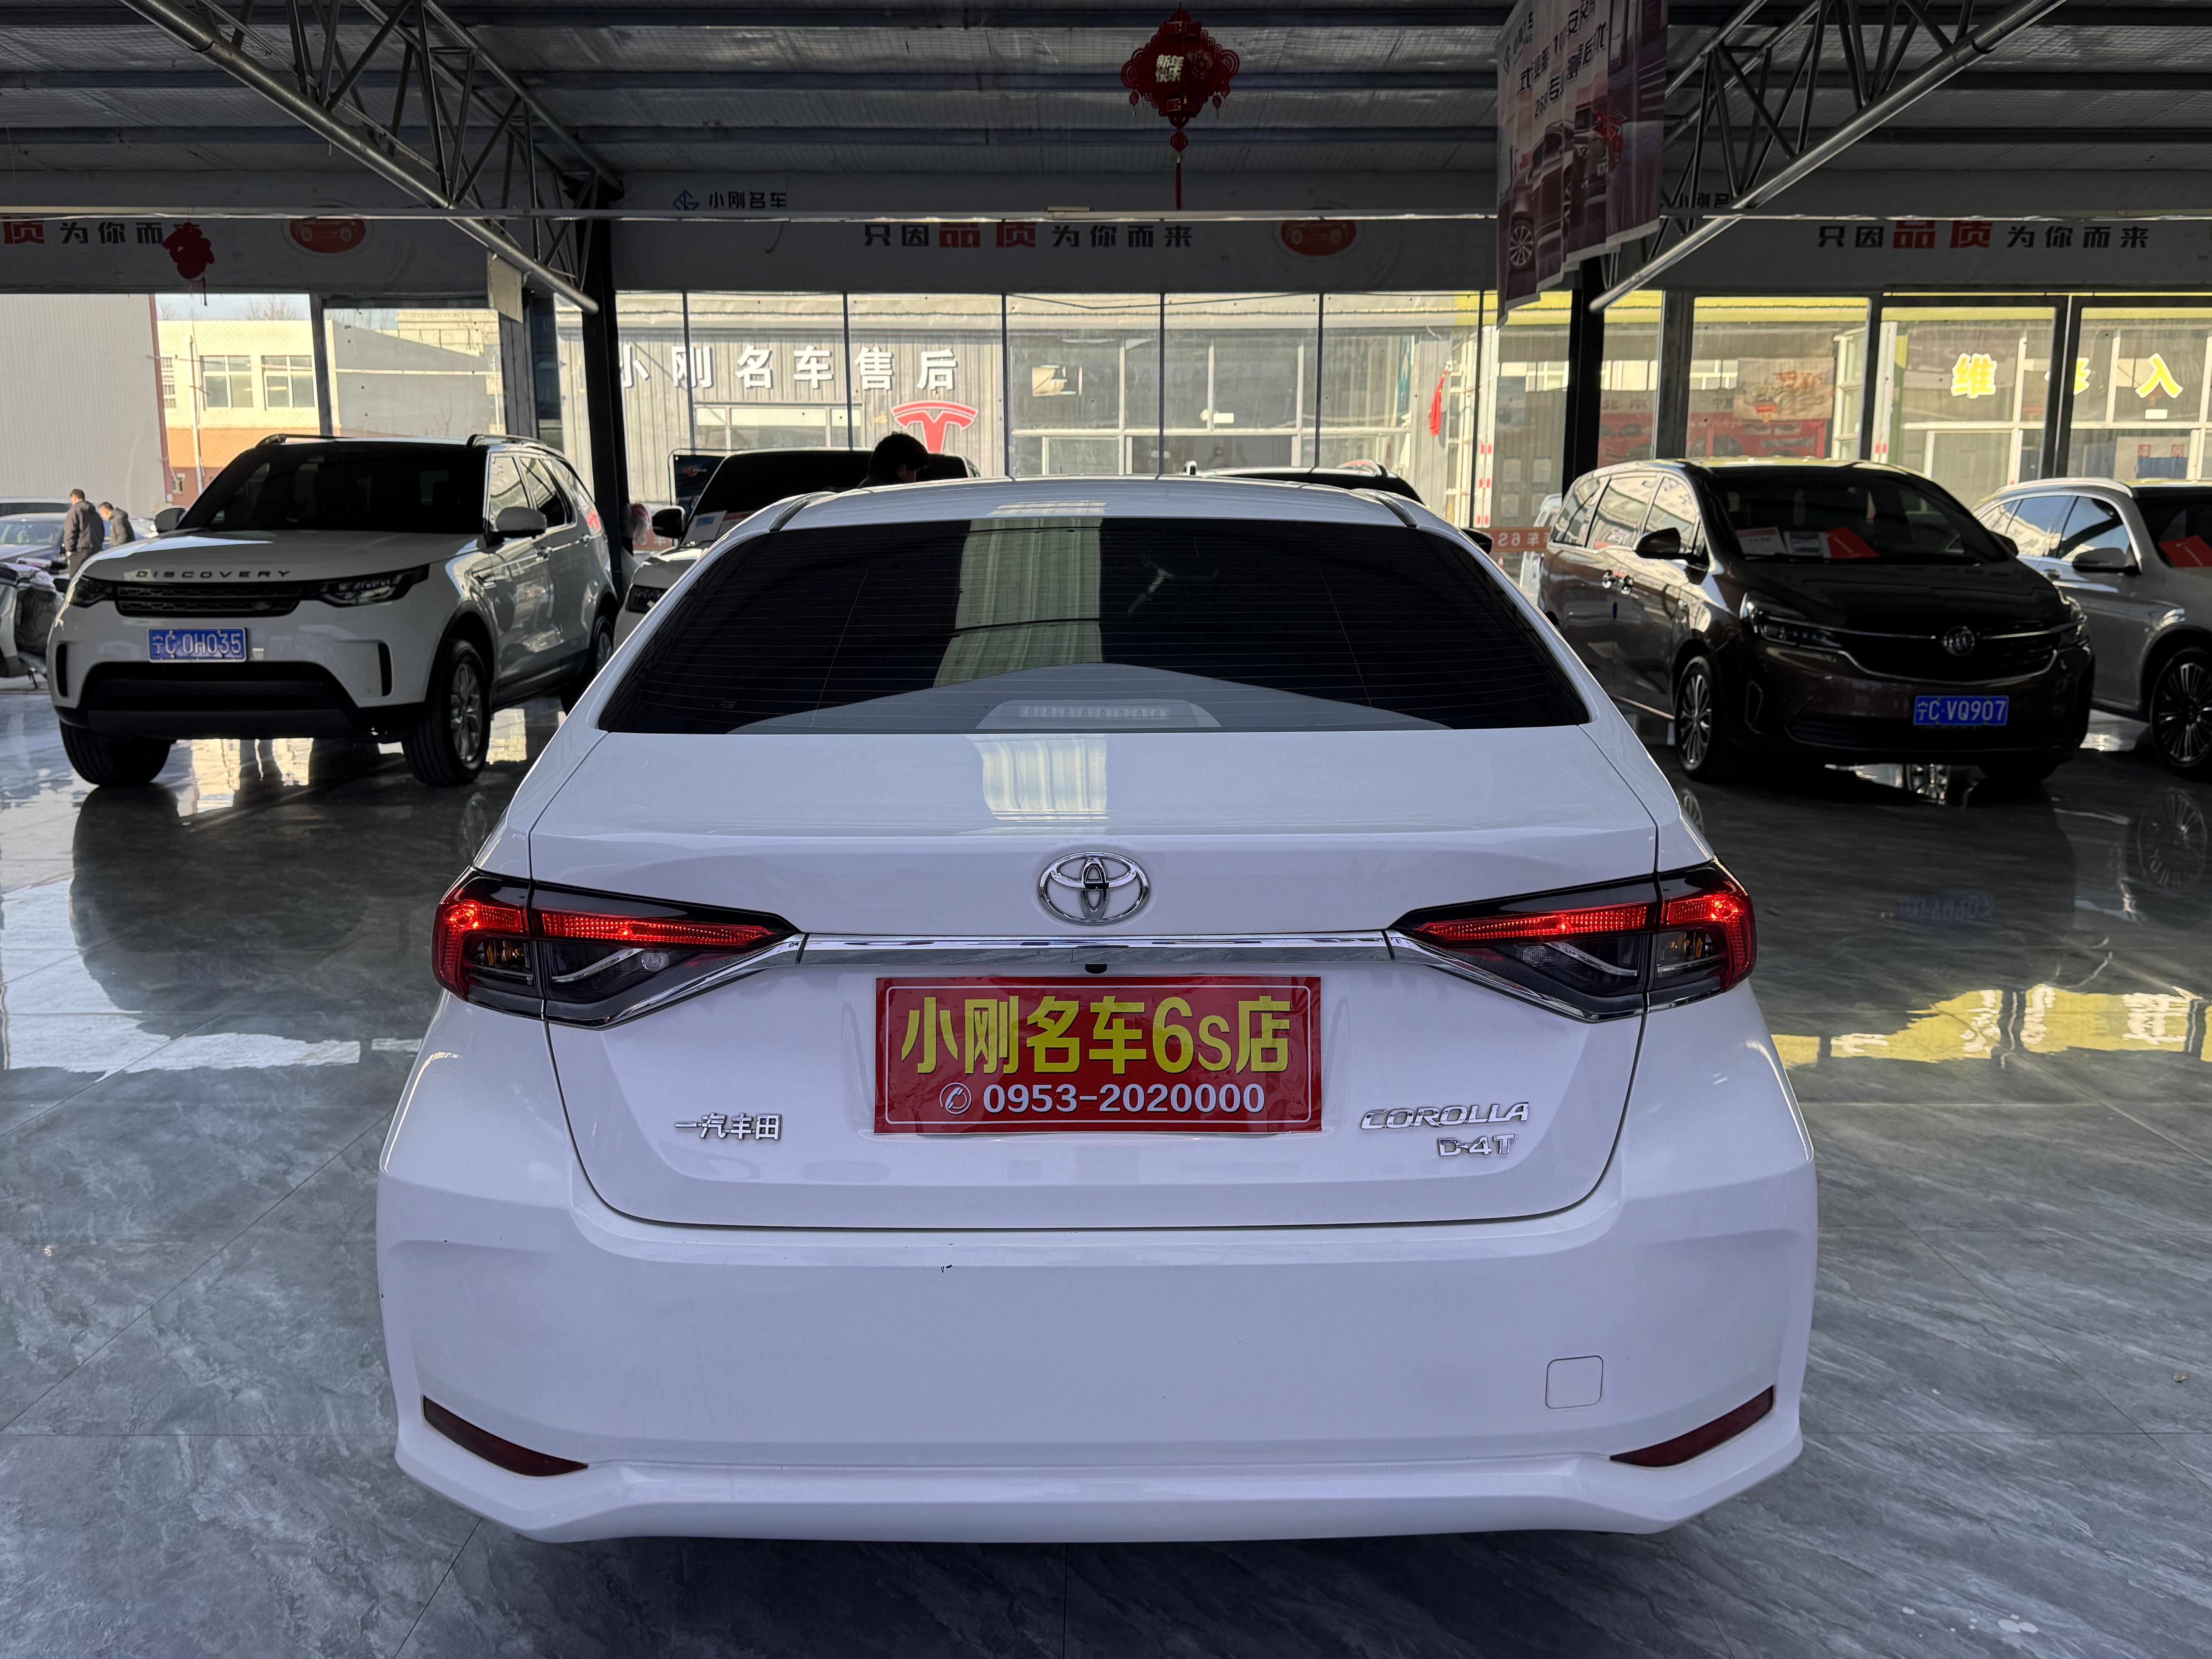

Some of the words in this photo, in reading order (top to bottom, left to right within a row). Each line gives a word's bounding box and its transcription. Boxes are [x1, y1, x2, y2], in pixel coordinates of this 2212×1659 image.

[708, 191, 787, 209] 小刚名车
[2, 215, 200, 244] 质为你而
[620, 344, 957, 390] 小刚名车售后
[136, 570, 291, 579] DISCOVERY
[901, 995, 1291, 1075] 小刚名车6s店
[984, 1083, 1265, 1114] 0953-2020000
[675, 1113, 782, 1140] 一汽丰田
[1360, 1102, 1529, 1130] COROLLA
[1437, 1133, 1516, 1157] D-4T
